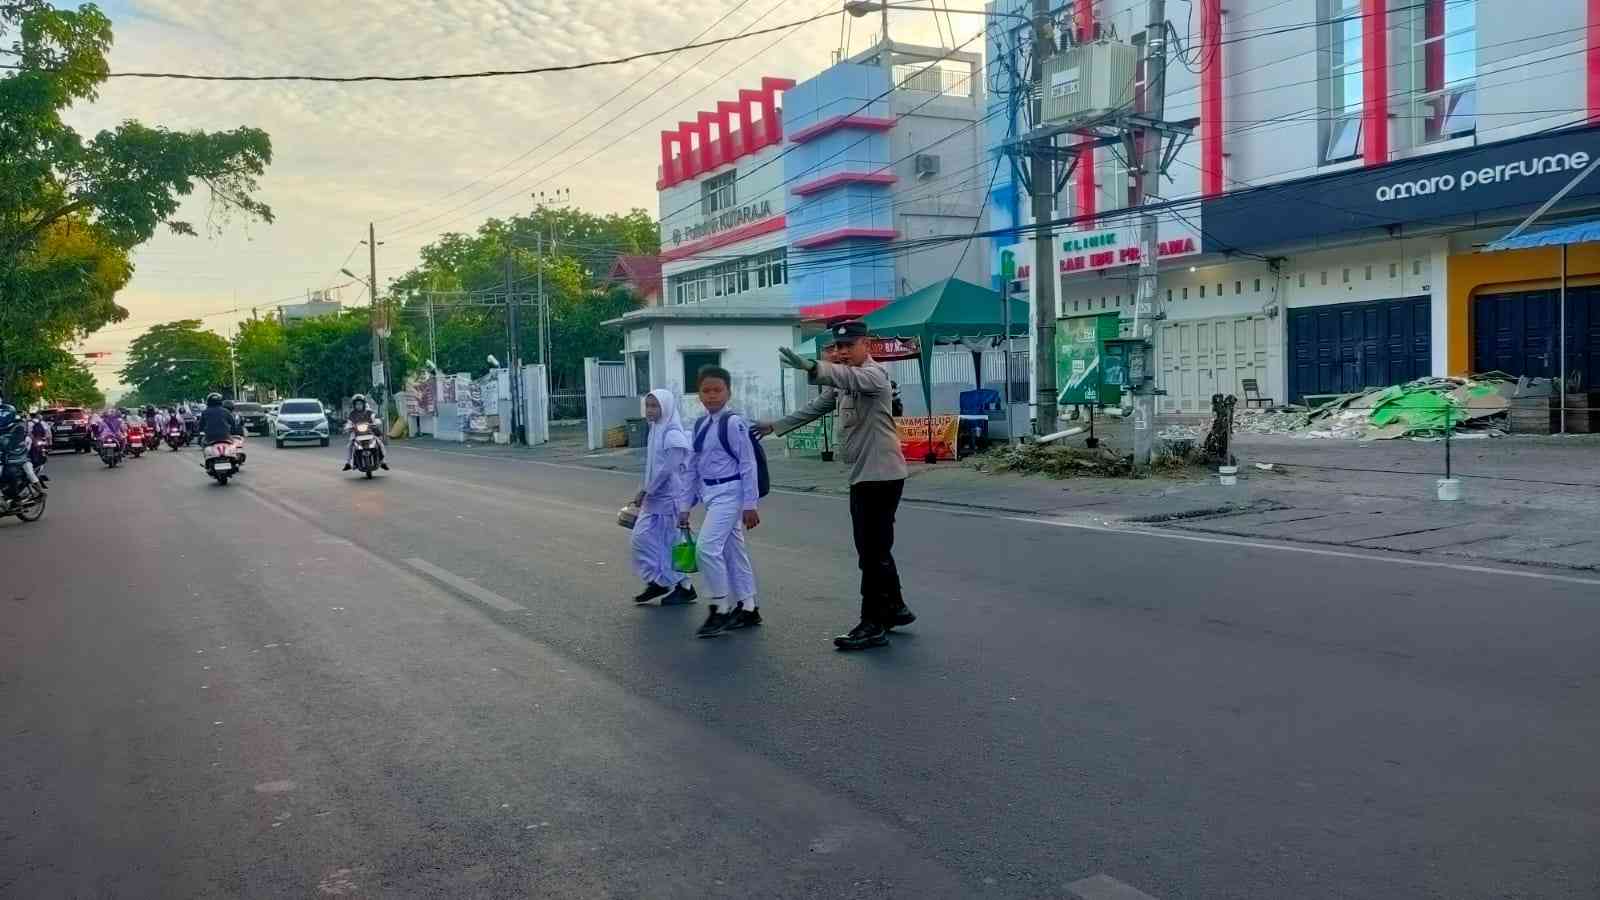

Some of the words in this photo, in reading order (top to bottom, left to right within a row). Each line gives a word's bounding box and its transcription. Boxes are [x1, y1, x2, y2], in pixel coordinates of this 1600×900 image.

[1375, 174, 1456, 201] amaro
[1460, 151, 1590, 191] perfume
[719, 200, 771, 231] KUTARAJA
[1063, 233, 1116, 251] KLINIK
